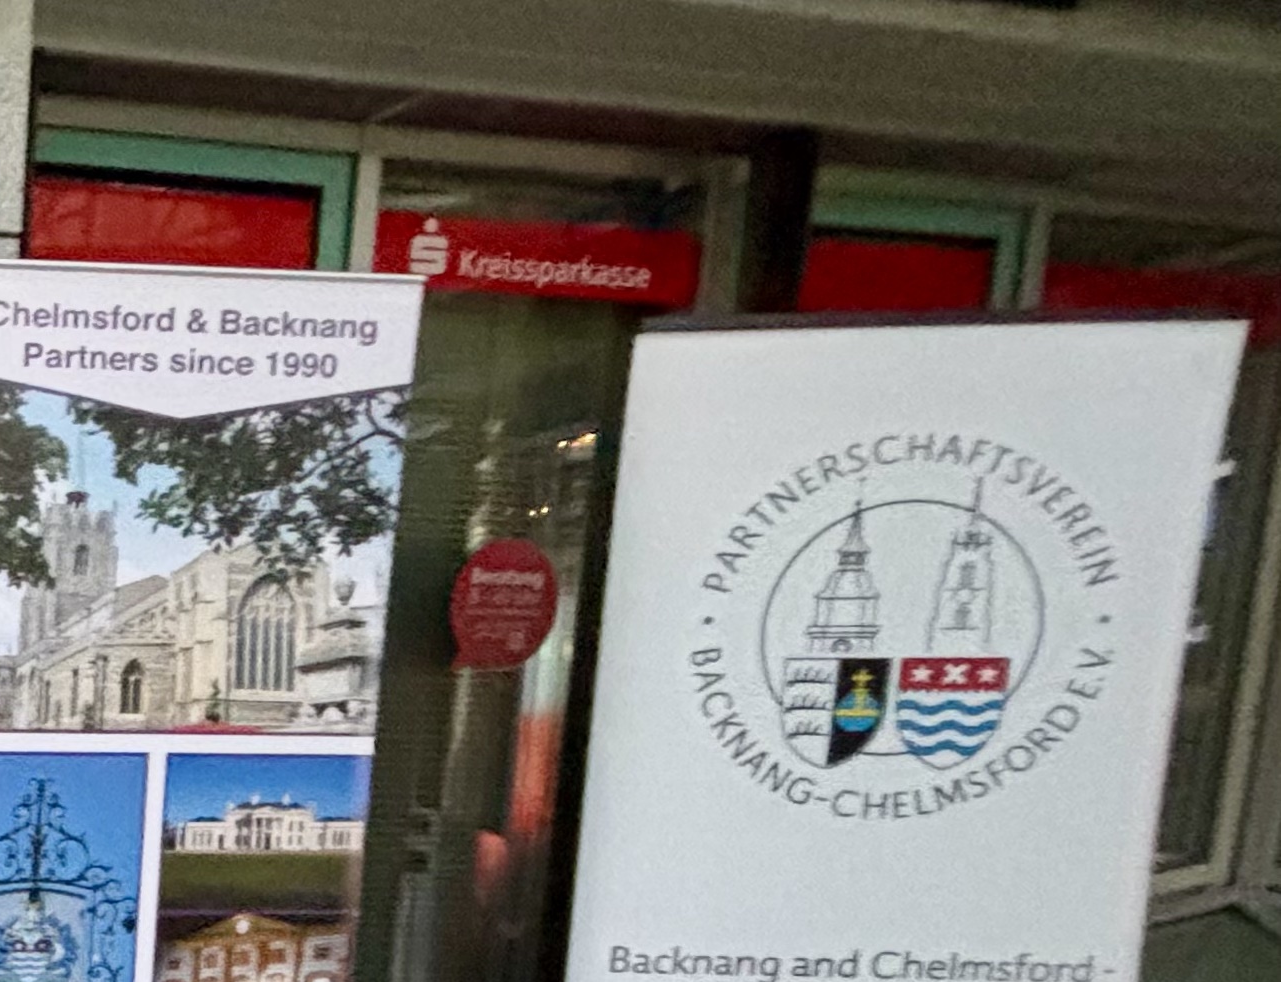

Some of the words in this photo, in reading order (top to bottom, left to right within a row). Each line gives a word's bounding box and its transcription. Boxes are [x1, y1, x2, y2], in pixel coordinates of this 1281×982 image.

[457, 250, 652, 289] Kreissparkasse
[186, 308, 209, 333] &
[219, 309, 379, 346] Backnang
[23, 342, 159, 373] Partners
[169, 348, 254, 376] since
[266, 352, 338, 379] 1990
[702, 432, 1120, 594] PARTNERSCHAFTSVEREIN
[690, 647, 1081, 819] BACKNANG-CHELMSFORD
[792, 949, 860, 979] and
